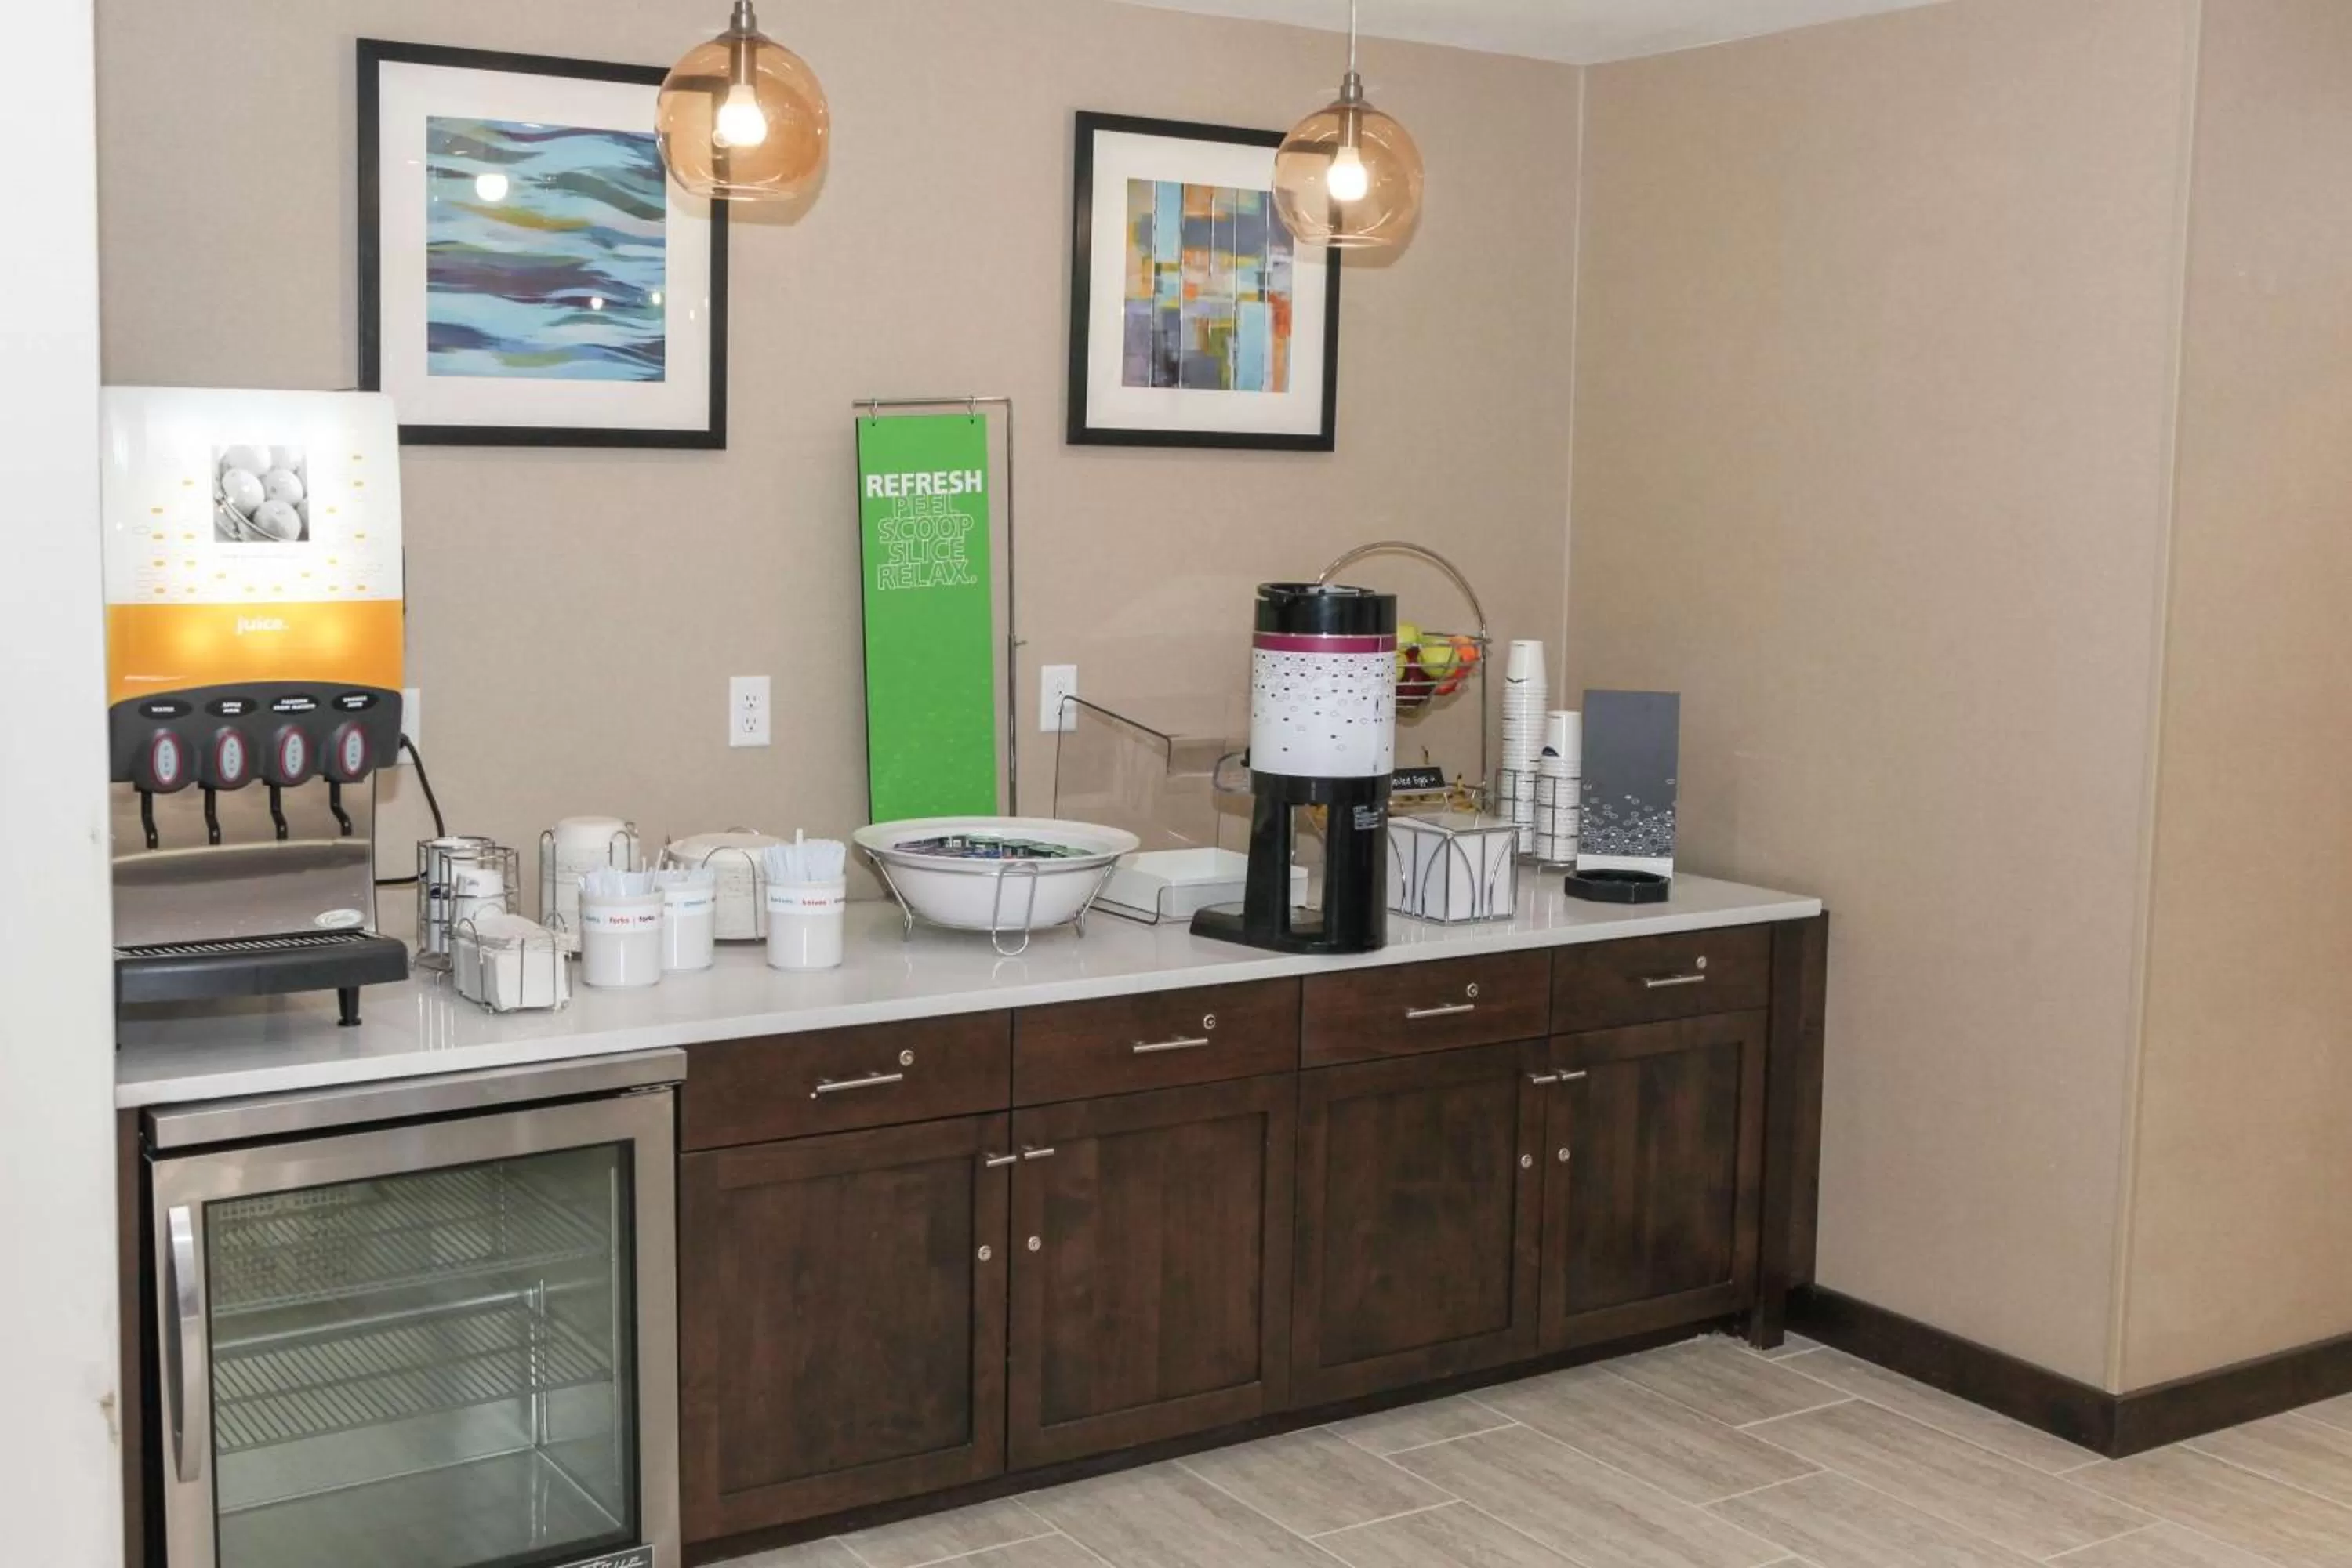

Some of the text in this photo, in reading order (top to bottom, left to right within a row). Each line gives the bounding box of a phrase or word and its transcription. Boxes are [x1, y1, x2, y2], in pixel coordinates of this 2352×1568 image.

[866, 470, 982, 498] REFRESH
[893, 493, 960, 519] PEEL
[877, 514, 975, 543] SCOOP
[888, 538, 966, 564] SLICE
